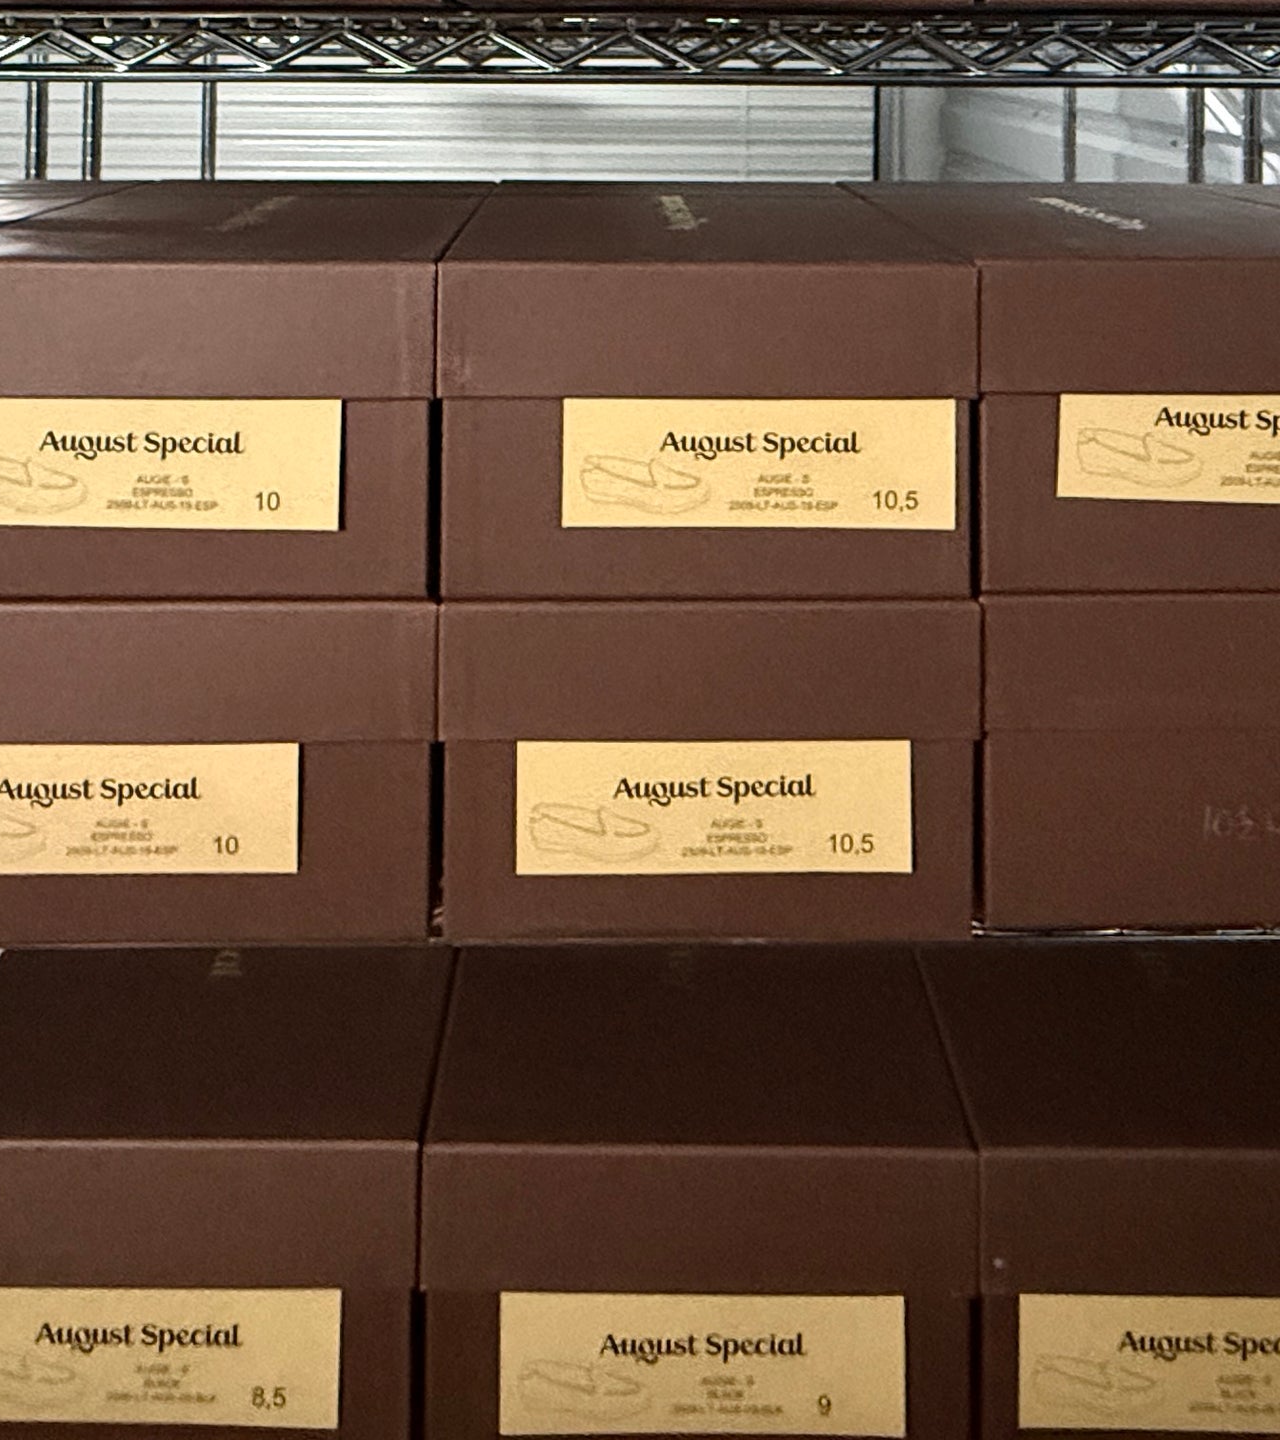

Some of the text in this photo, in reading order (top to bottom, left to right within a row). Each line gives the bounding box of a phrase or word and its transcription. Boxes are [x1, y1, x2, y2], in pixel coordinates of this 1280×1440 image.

[1154, 407, 1249, 436] August
[39, 431, 244, 460] August Special
[660, 431, 861, 460] August Special
[256, 492, 280, 511] 10
[100, 777, 201, 807] Special
[614, 774, 816, 807] August Special
[214, 835, 239, 855] 10
[35, 1323, 243, 1354] August Special
[600, 1332, 806, 1365] August Special
[1119, 1331, 1217, 1362] August
[817, 1394, 832, 1416] 9
